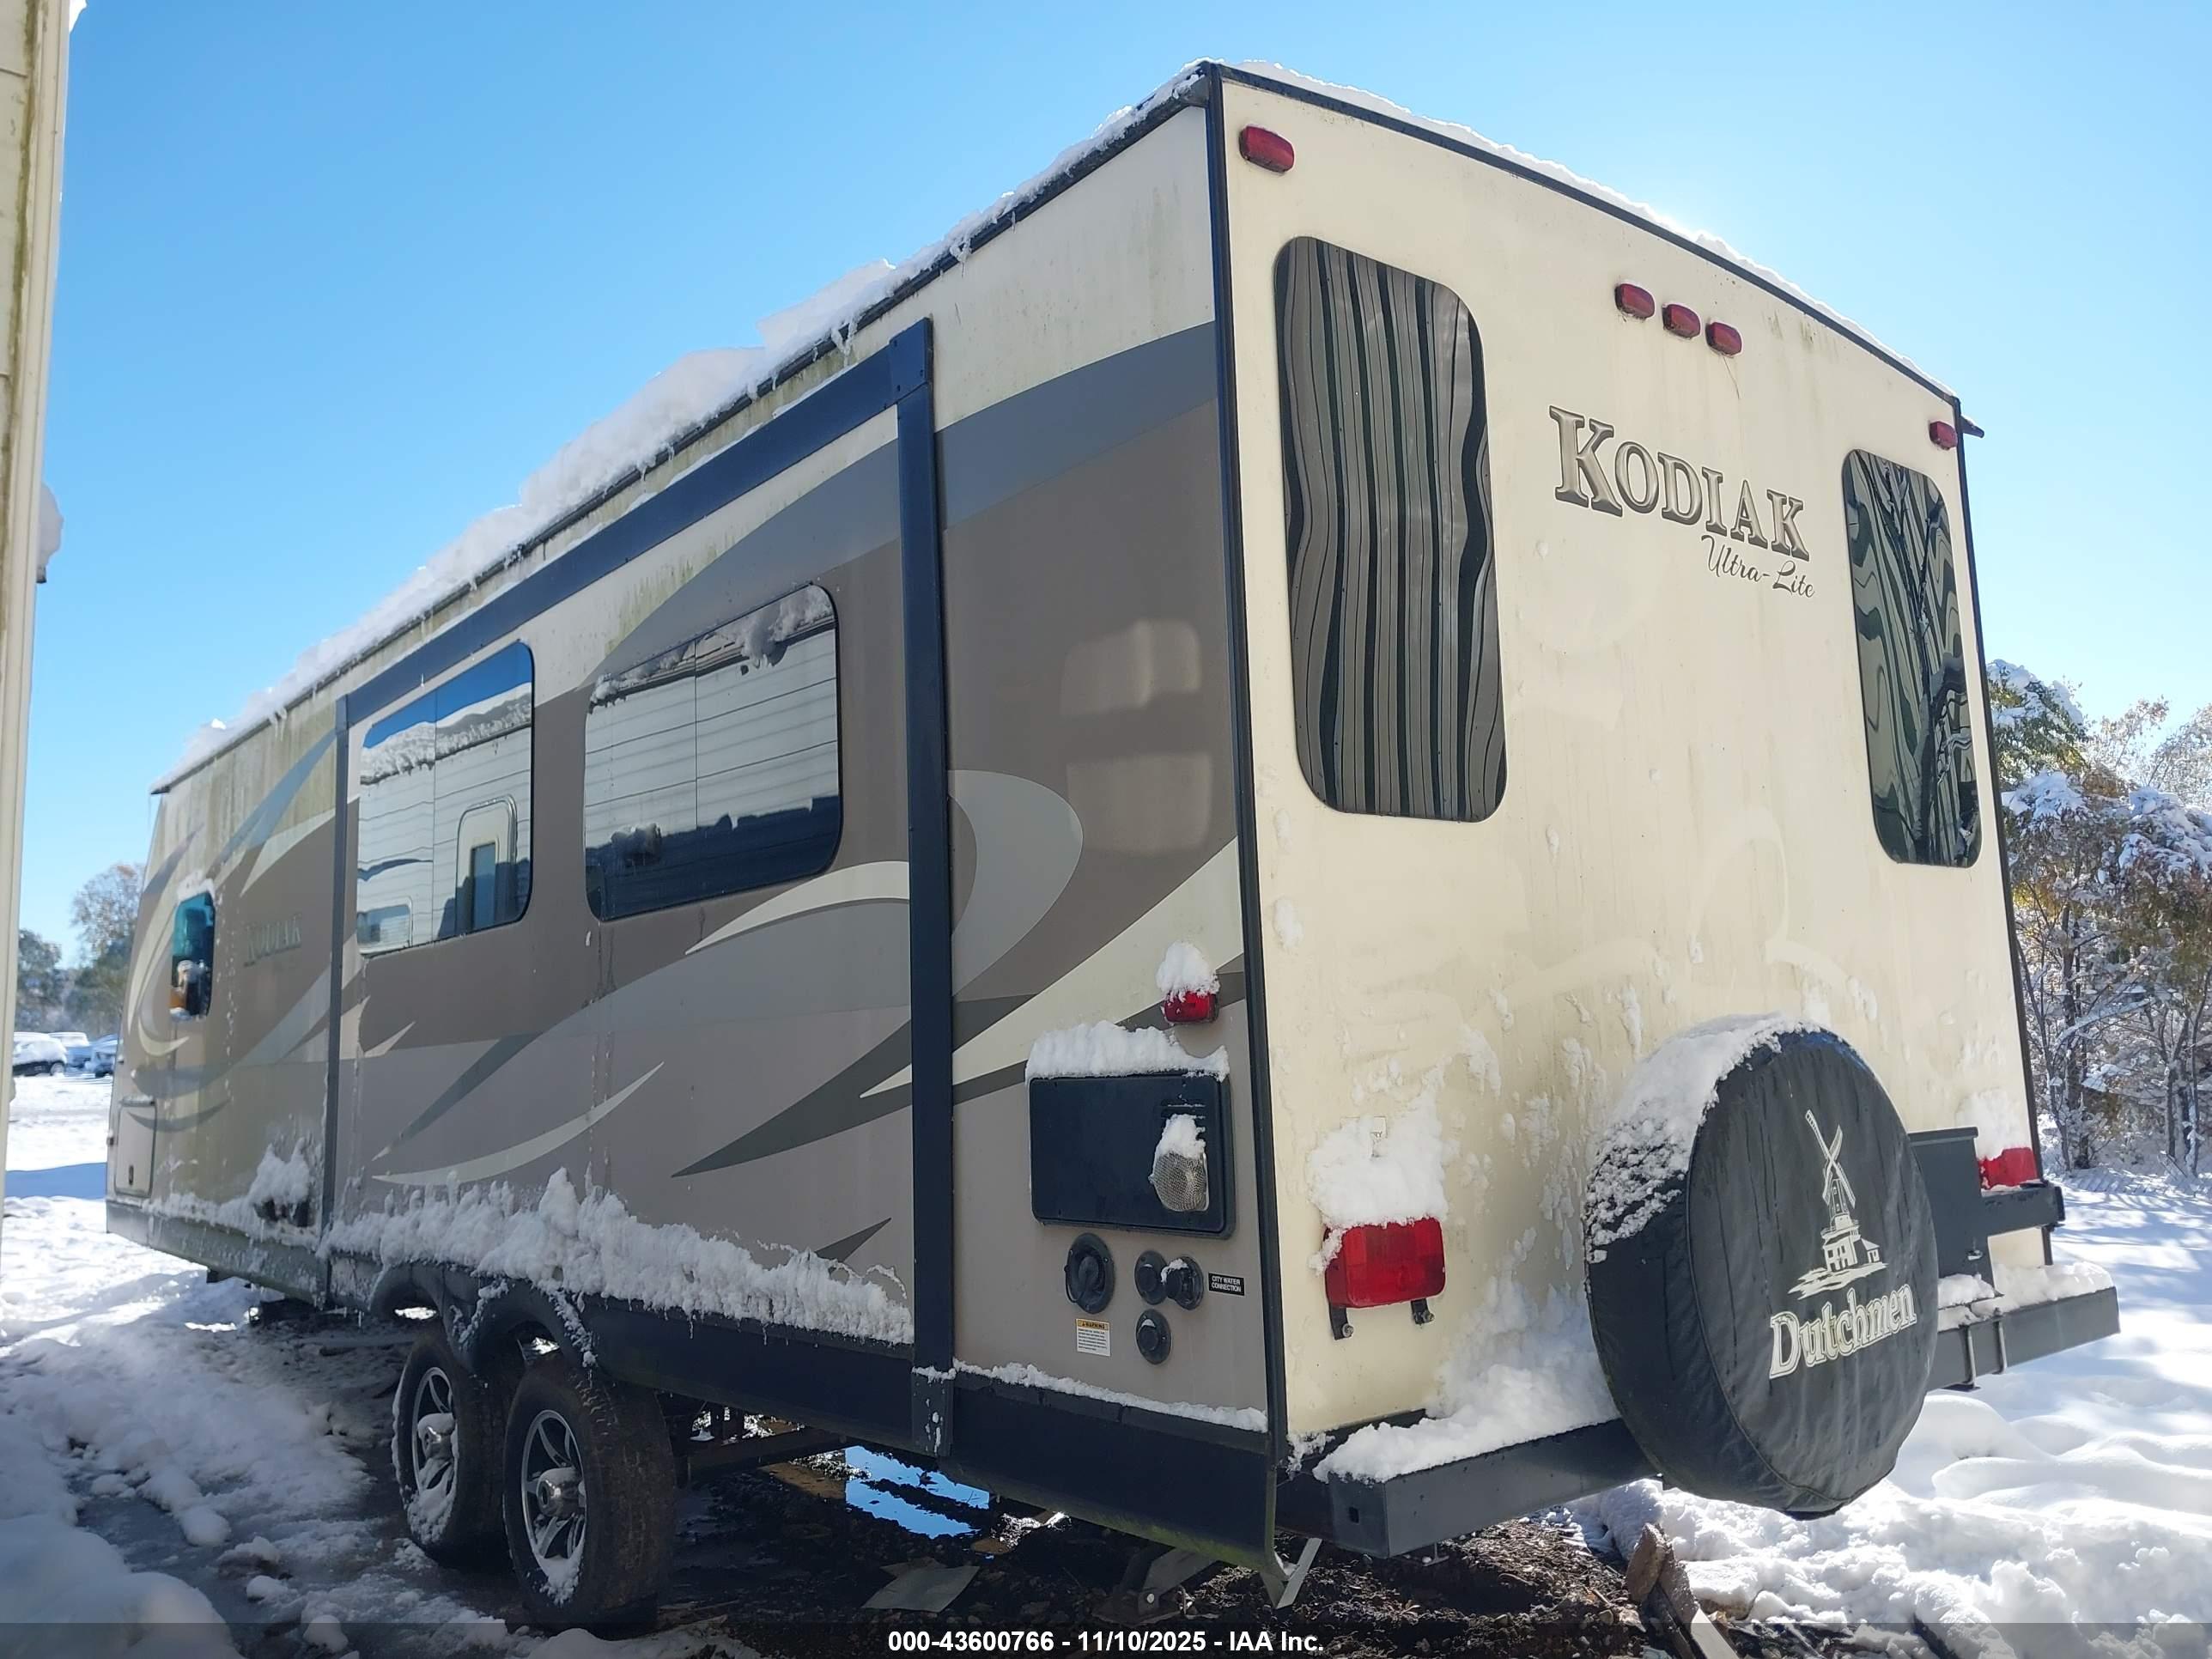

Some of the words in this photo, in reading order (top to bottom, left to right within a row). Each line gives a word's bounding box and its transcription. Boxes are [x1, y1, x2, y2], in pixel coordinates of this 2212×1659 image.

[1549, 404, 1810, 562] KODIAK
[1701, 533, 1815, 599] Ultra-Lite
[1212, 1282, 1242, 1292] CONNECTION
[1223, 1277, 1241, 1285] WATER
[1769, 1284, 1917, 1379] Dutchmen
